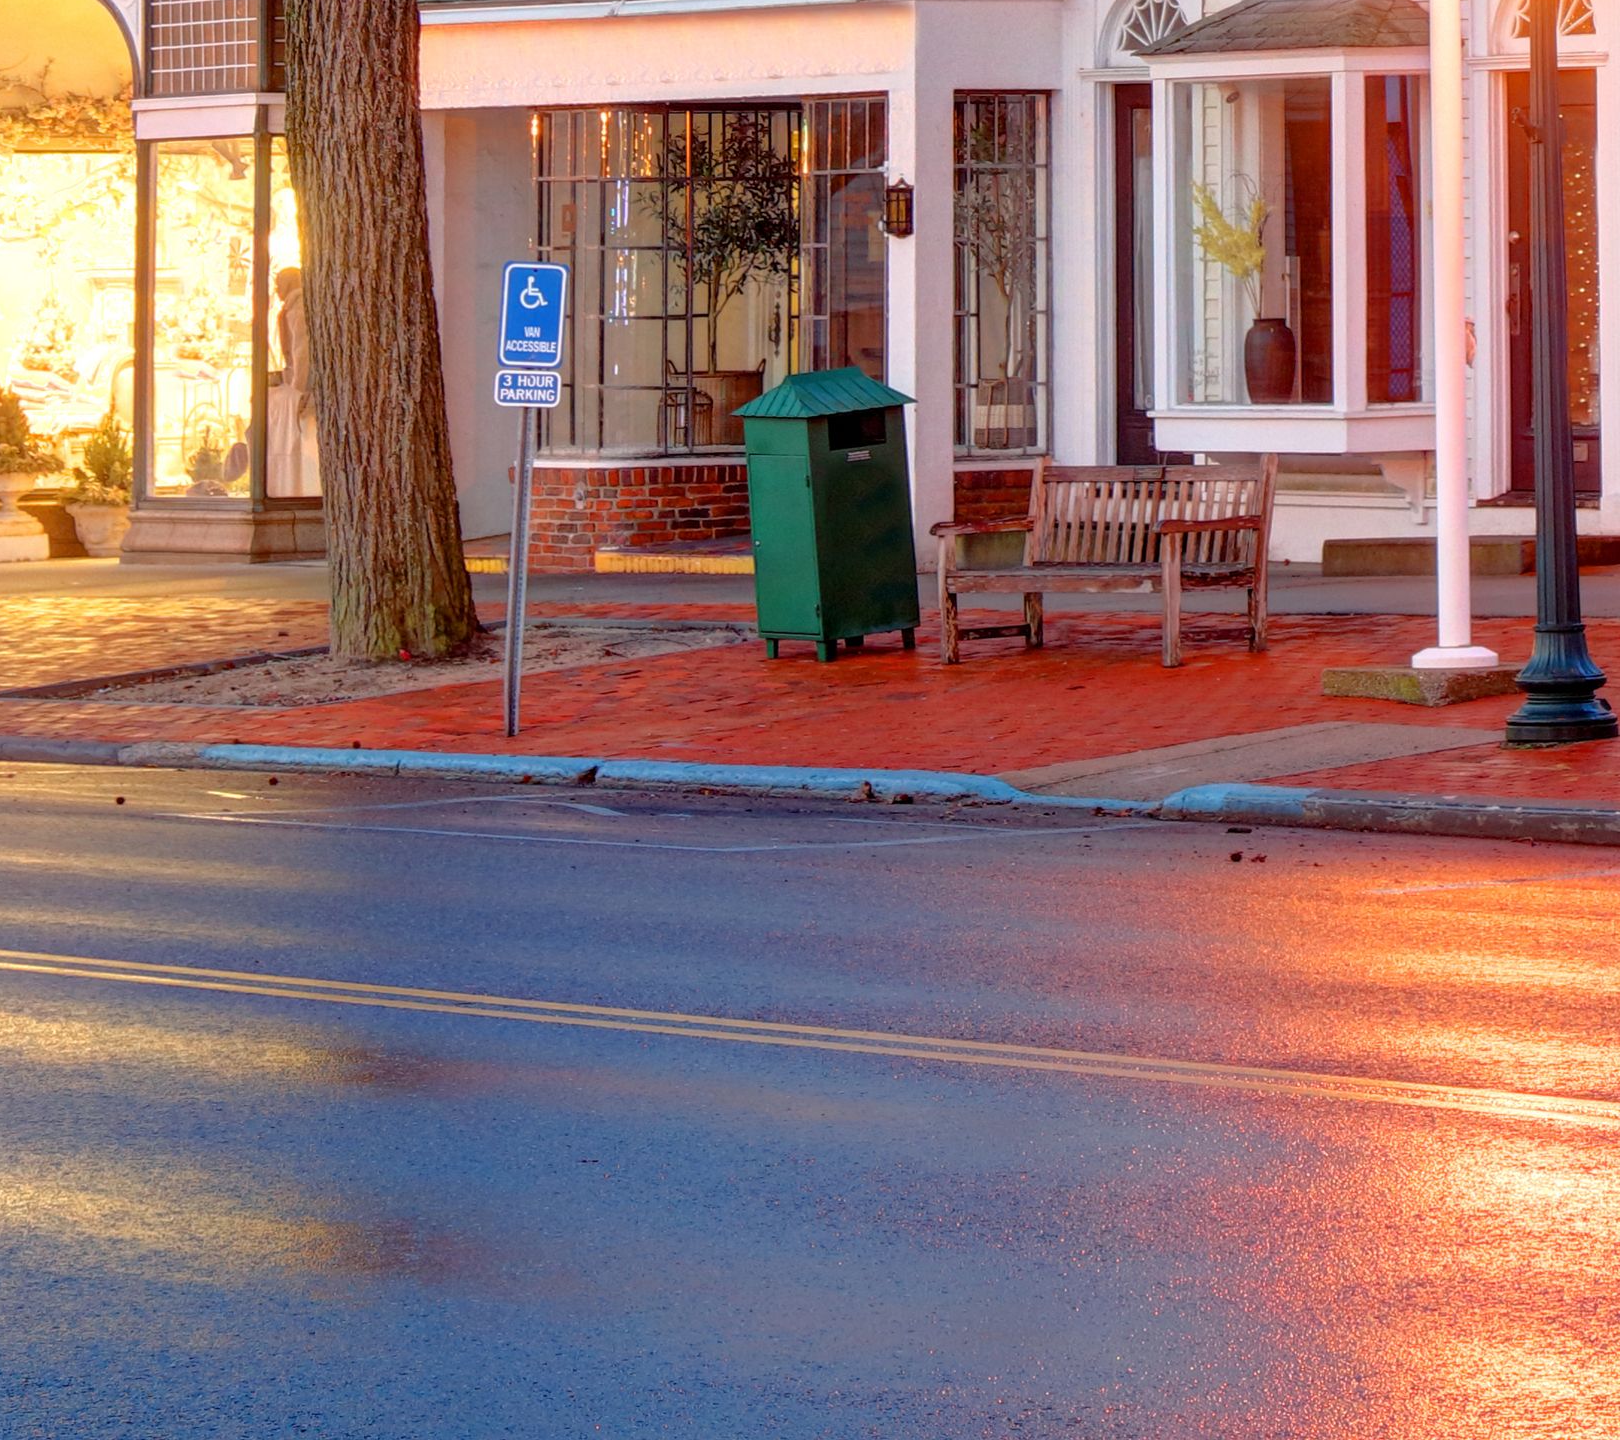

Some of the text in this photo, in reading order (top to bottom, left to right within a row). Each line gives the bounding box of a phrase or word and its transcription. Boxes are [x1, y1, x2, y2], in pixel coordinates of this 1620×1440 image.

[524, 326, 541, 338] VAN
[505, 340, 557, 353] ACCESSIBLE
[503, 374, 554, 387] 3 HOUR
[500, 389, 555, 401] PARKING
